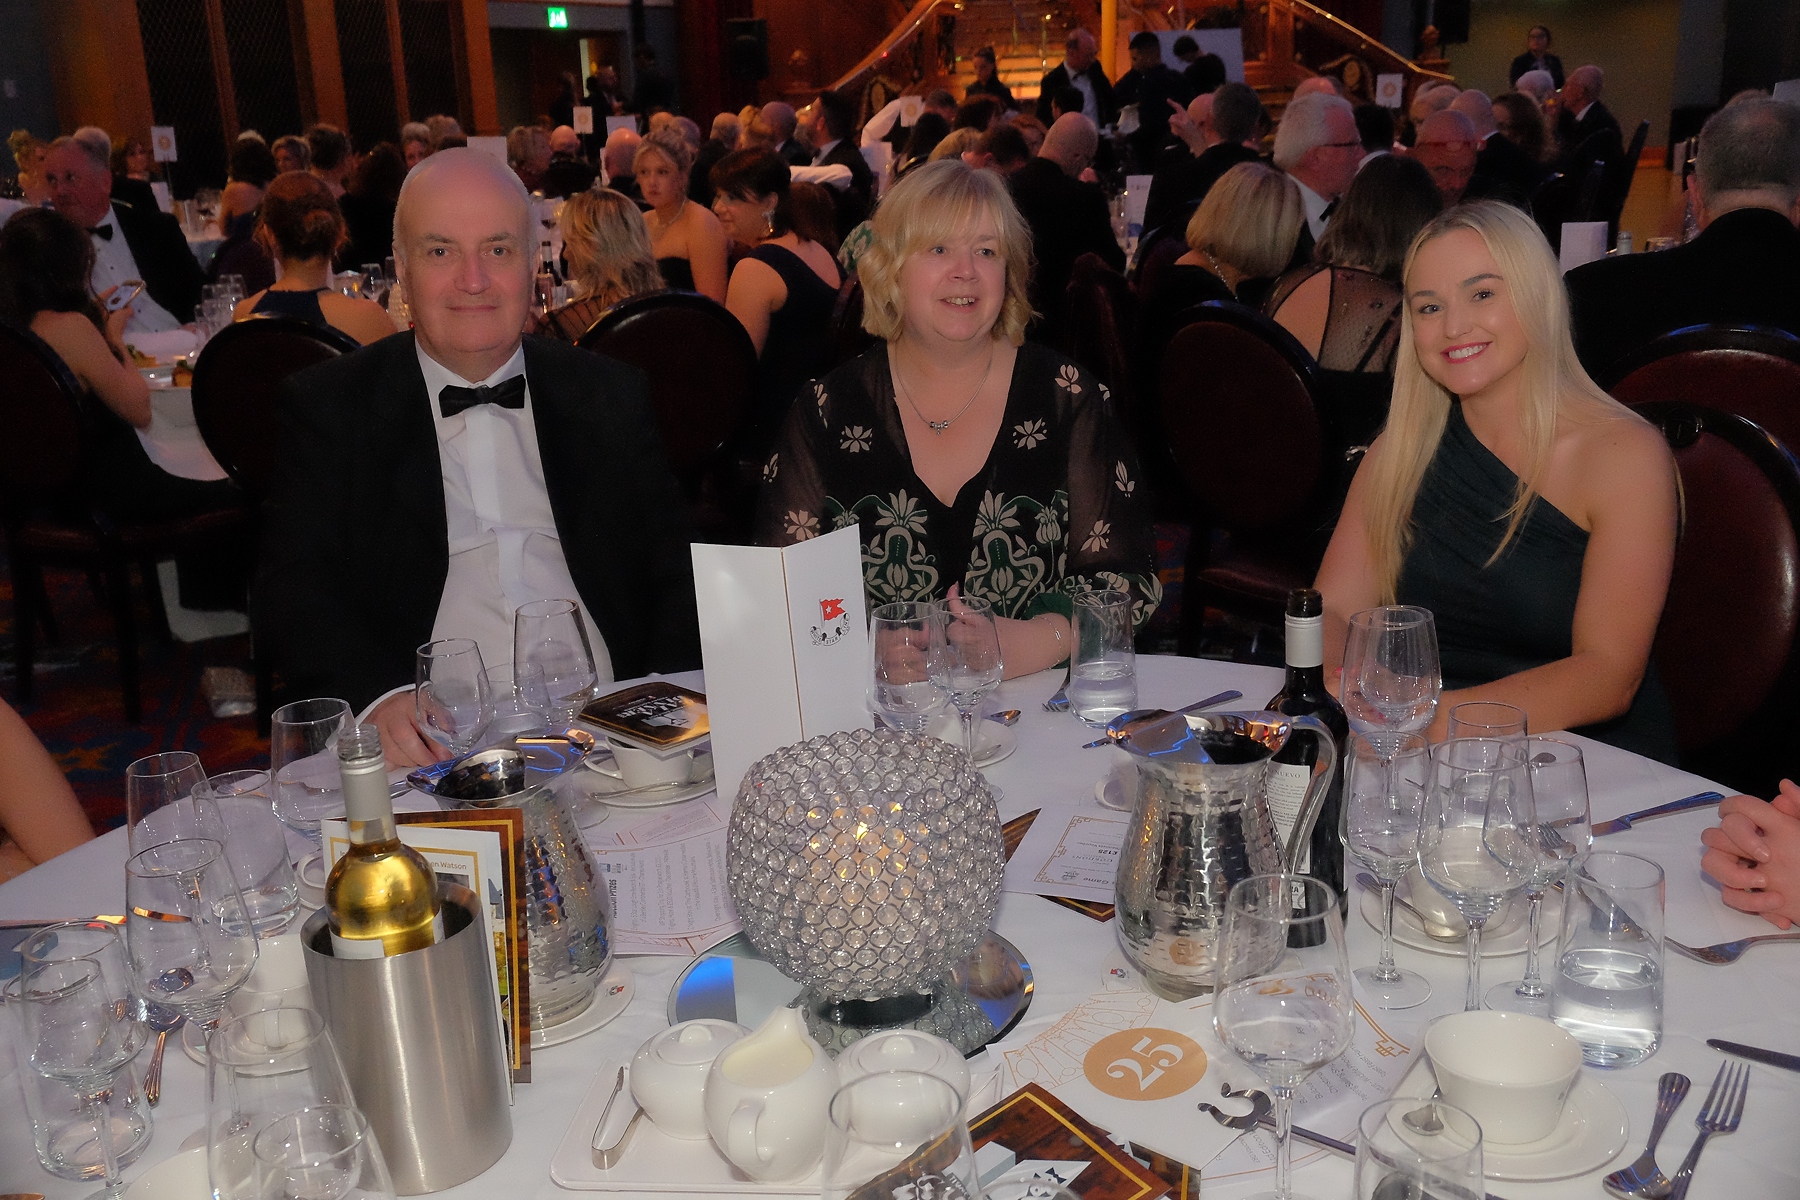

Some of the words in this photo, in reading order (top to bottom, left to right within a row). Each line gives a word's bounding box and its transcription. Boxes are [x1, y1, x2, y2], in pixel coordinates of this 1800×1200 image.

[825, 636, 838, 644] STAR
[440, 862, 467, 870] Watson
[1106, 1035, 1184, 1092] 25
